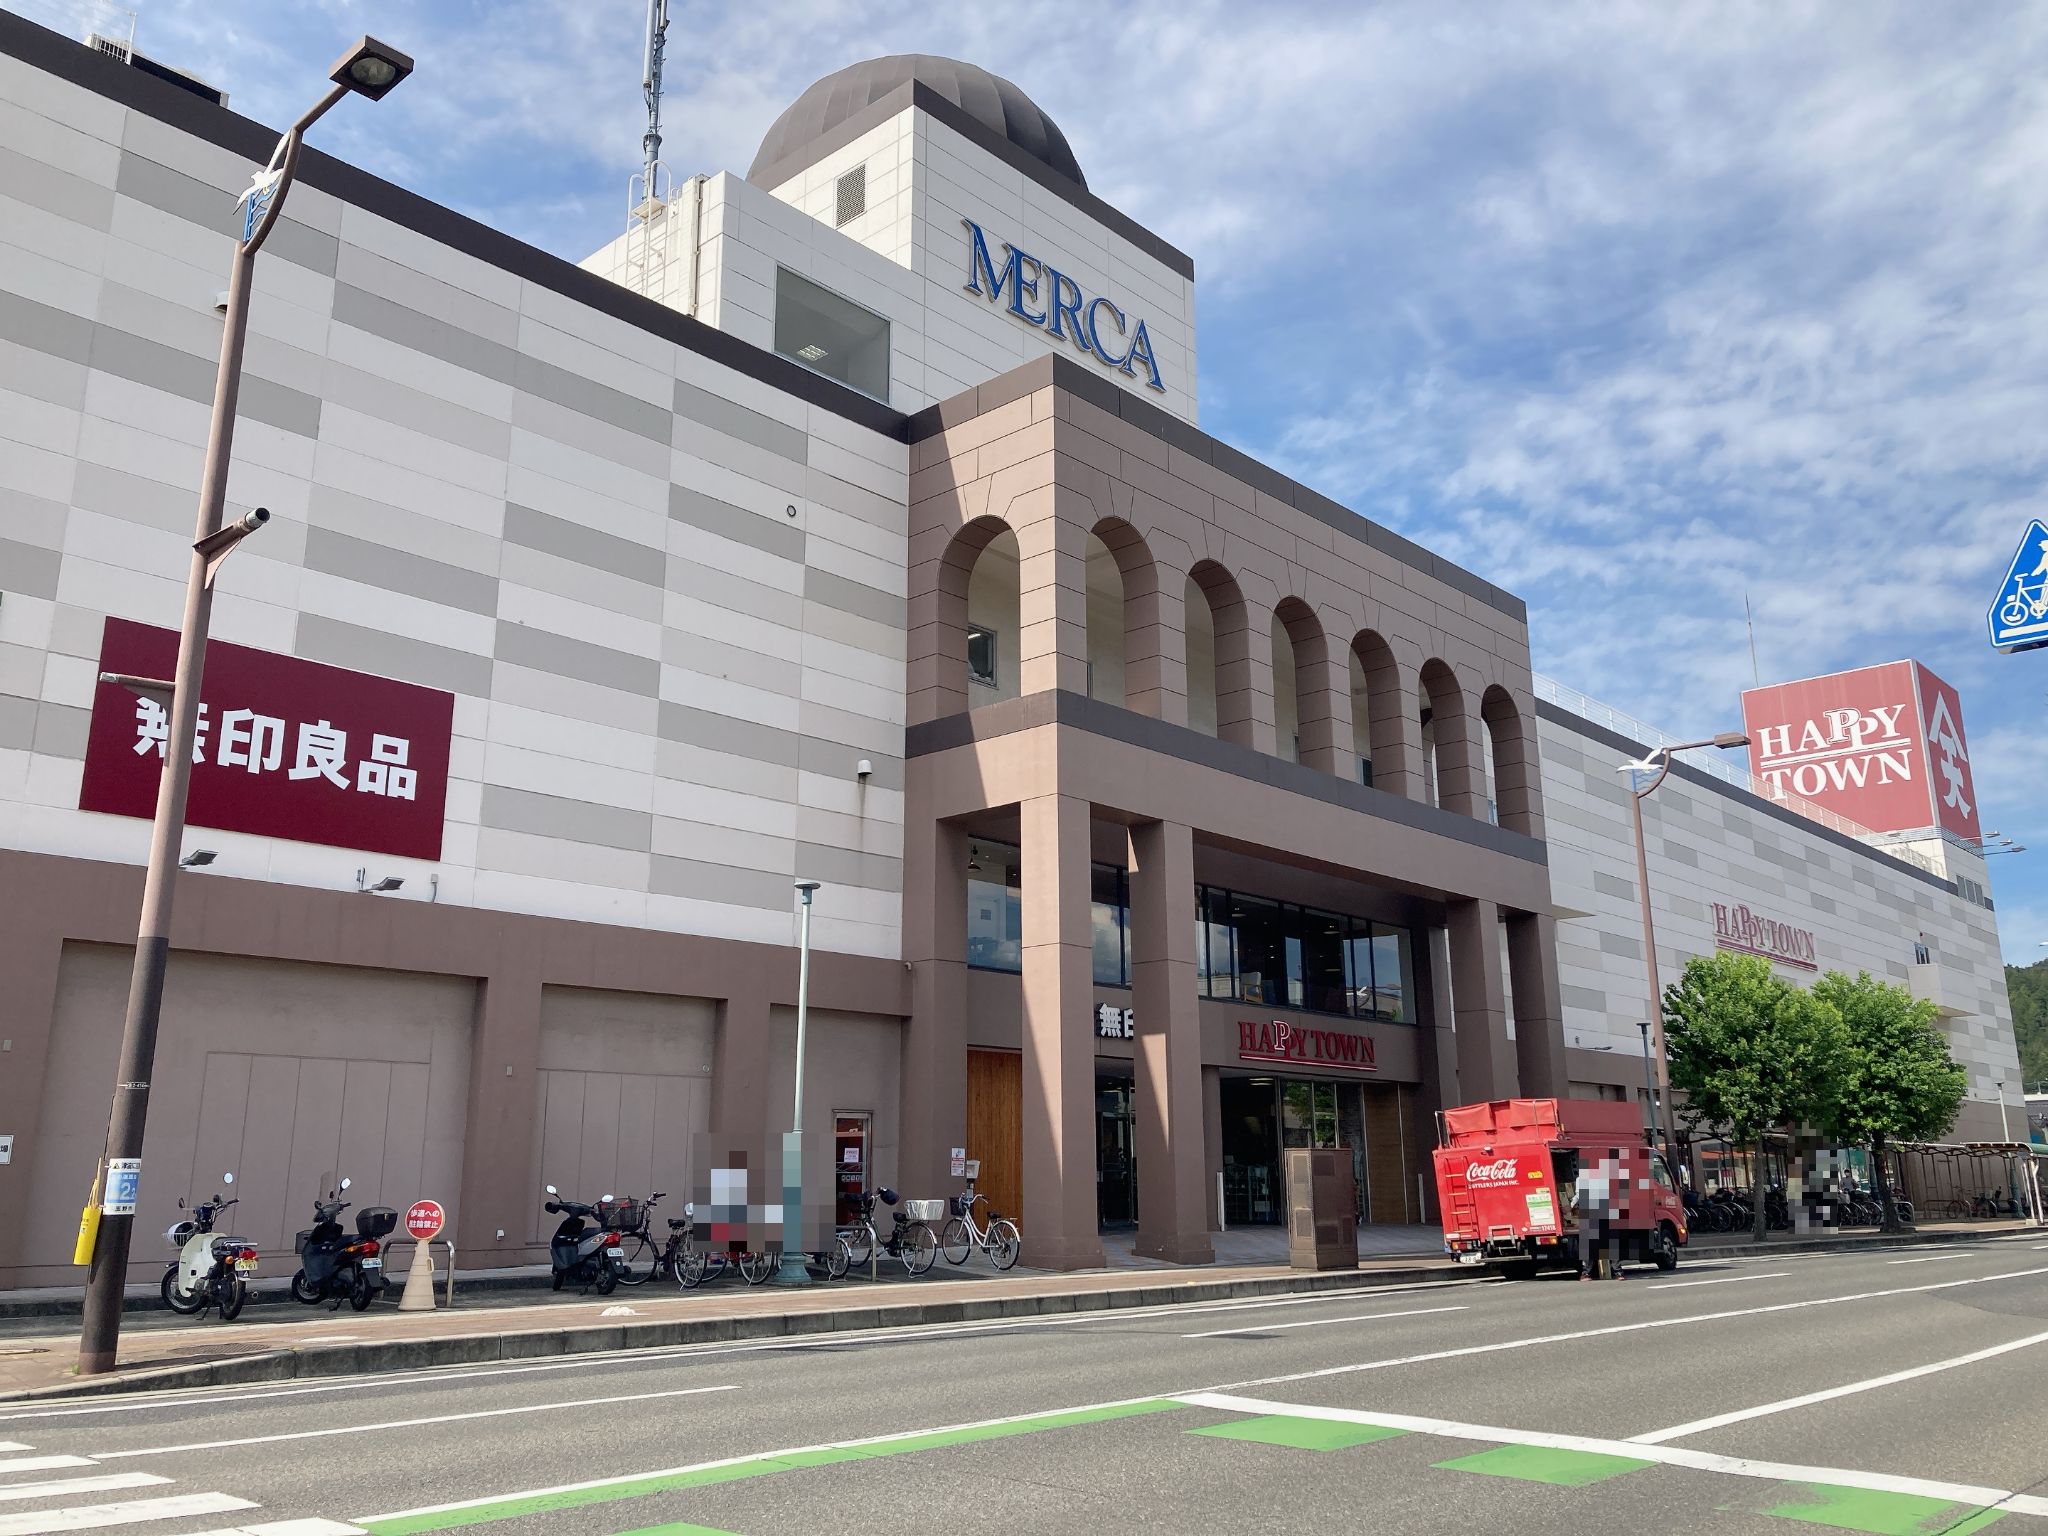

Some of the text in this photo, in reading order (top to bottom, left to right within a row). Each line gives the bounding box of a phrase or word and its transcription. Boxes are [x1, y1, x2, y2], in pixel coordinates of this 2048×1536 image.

[961, 218, 1167, 393] MERCA
[1756, 703, 1906, 759] HAPPY
[1761, 748, 1912, 801] TOWN
[1711, 902, 1816, 960] HAPPY TOWN
[1238, 1020, 1376, 1063] HAPPY TOWN
[408, 1220, 439, 1229] 駐輪禁止
[410, 1209, 440, 1218] 歩道への
